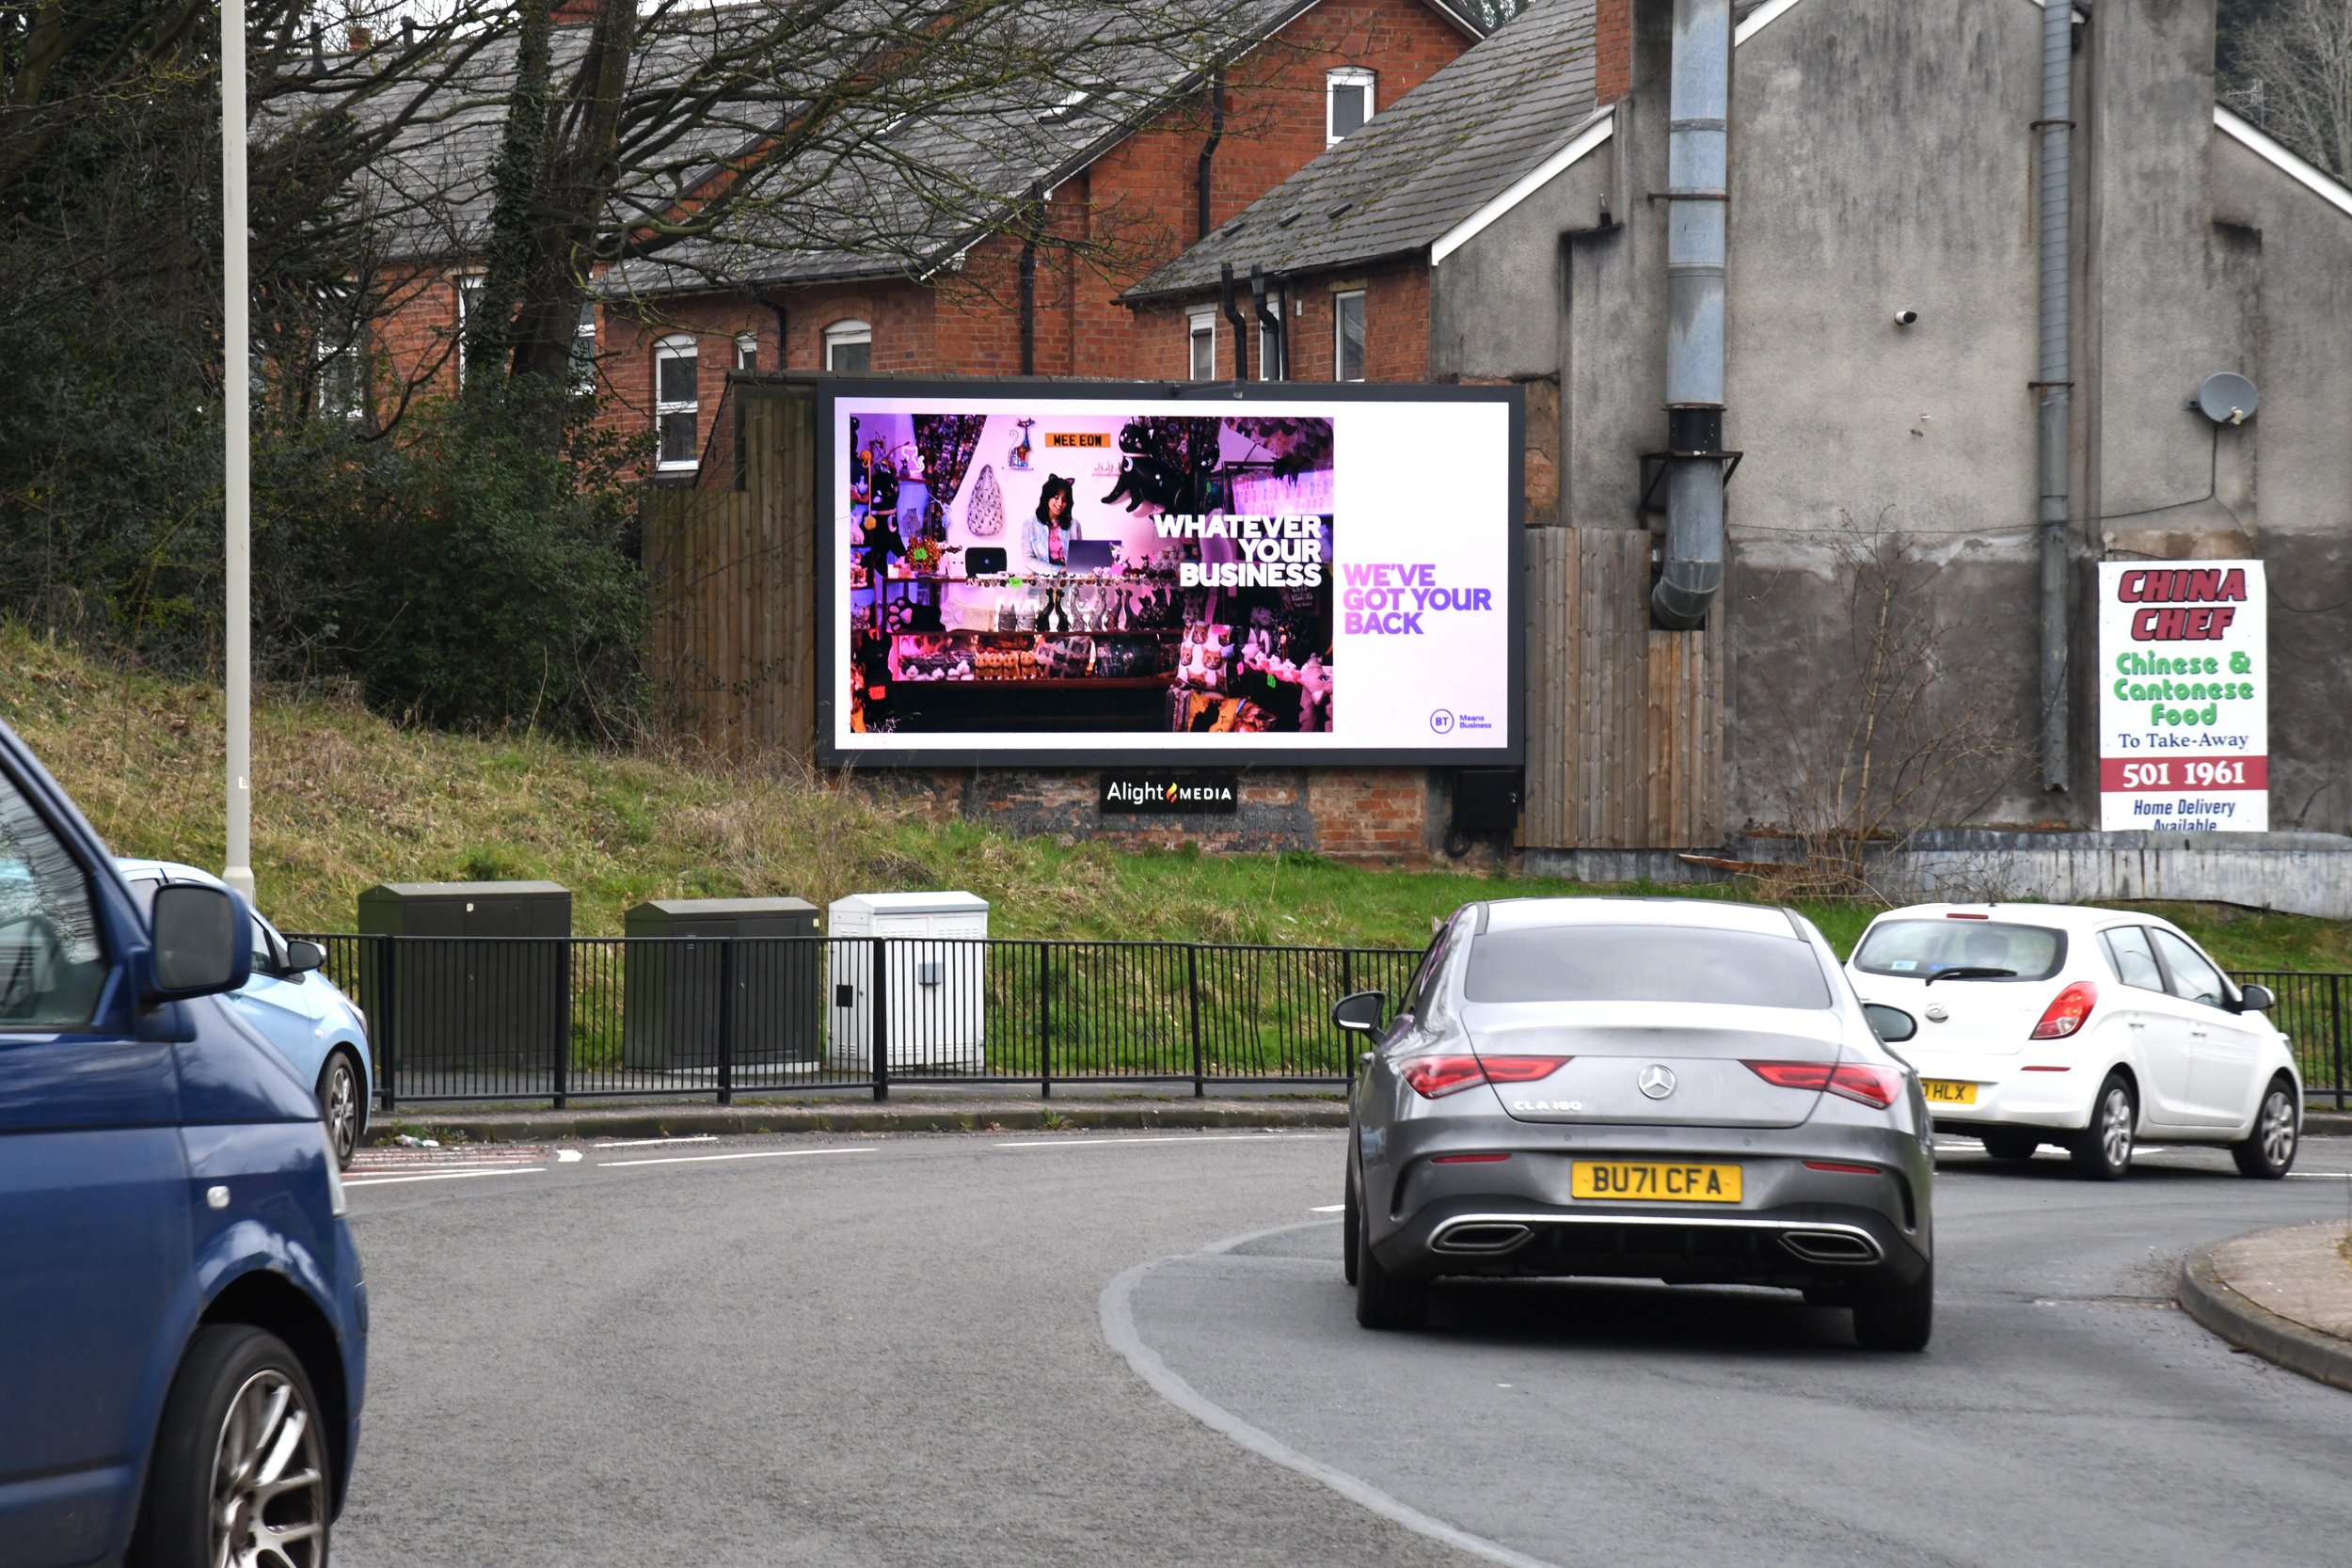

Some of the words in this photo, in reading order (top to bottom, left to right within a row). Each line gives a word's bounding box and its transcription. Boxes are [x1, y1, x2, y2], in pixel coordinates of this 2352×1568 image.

[1153, 515, 1322, 538] WHATEVER
[1237, 539, 1322, 562] YOUR
[1180, 562, 1322, 587] BUSINESS
[1343, 563, 1436, 586] WE'VE
[2117, 568, 2247, 603] CHINA
[1343, 588, 1405, 610] GOT
[1410, 588, 1492, 610] YOUR
[1344, 612, 1424, 634] BACK
[2130, 607, 2235, 641] CHEF
[2116, 650, 2218, 675] Chinese
[2229, 651, 2252, 674] &
[2113, 677, 2254, 702] Cantonese
[1435, 717, 1449, 726] BT
[2151, 704, 2217, 726] Food
[2118, 734, 2140, 749] To
[2146, 732, 2249, 751] Take-Away
[2122, 763, 2171, 788] 501
[2185, 761, 2246, 787] 1961
[1106, 781, 1165, 805] Alight
[1179, 787, 1232, 800] MEDIA
[2134, 800, 2173, 816] Home
[2177, 799, 2235, 817] Delivery
[1932, 1084, 1966, 1101] HLX
[1513, 1101, 1549, 1111] CLA
[1592, 1166, 1657, 1193] BU71
[1665, 1167, 1722, 1195] CFA
